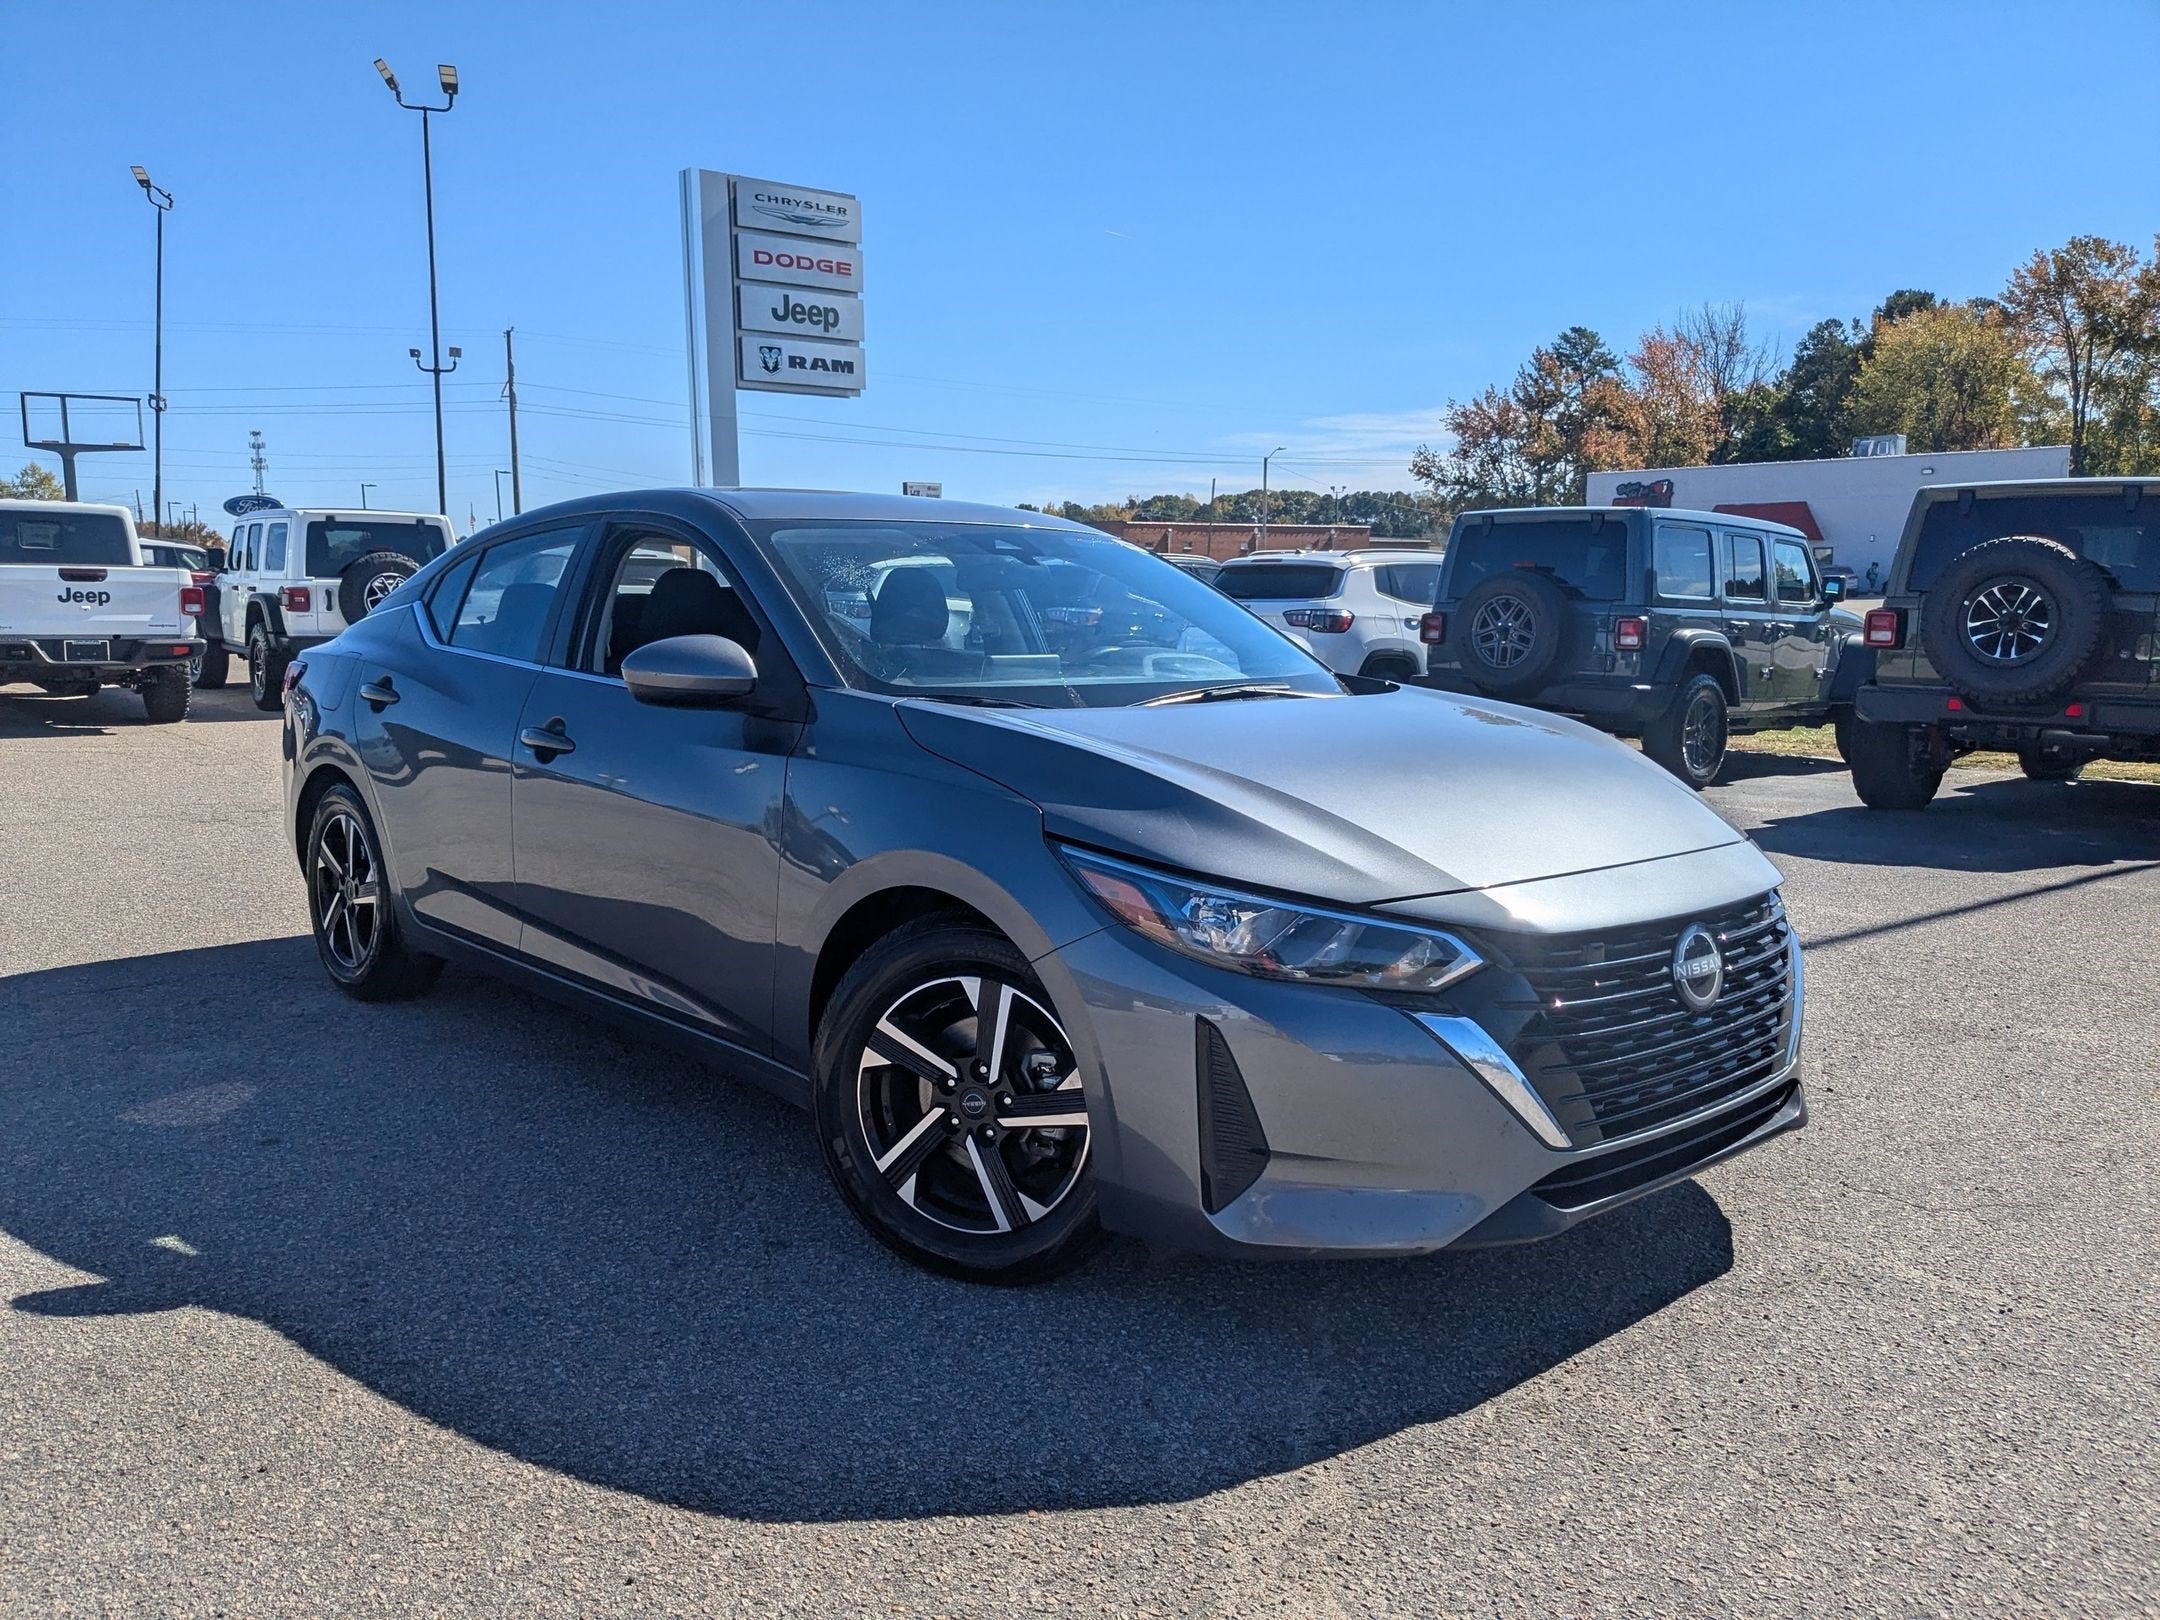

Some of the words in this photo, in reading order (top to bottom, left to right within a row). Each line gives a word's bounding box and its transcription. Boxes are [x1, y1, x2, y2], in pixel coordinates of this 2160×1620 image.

[754, 194, 848, 216] CHRYSLER
[753, 250, 852, 276] DODGE
[771, 294, 840, 333] Jeep
[788, 355, 854, 374] RAM
[57, 587, 111, 606] Jeep
[1675, 957, 1721, 977] NISSAN
